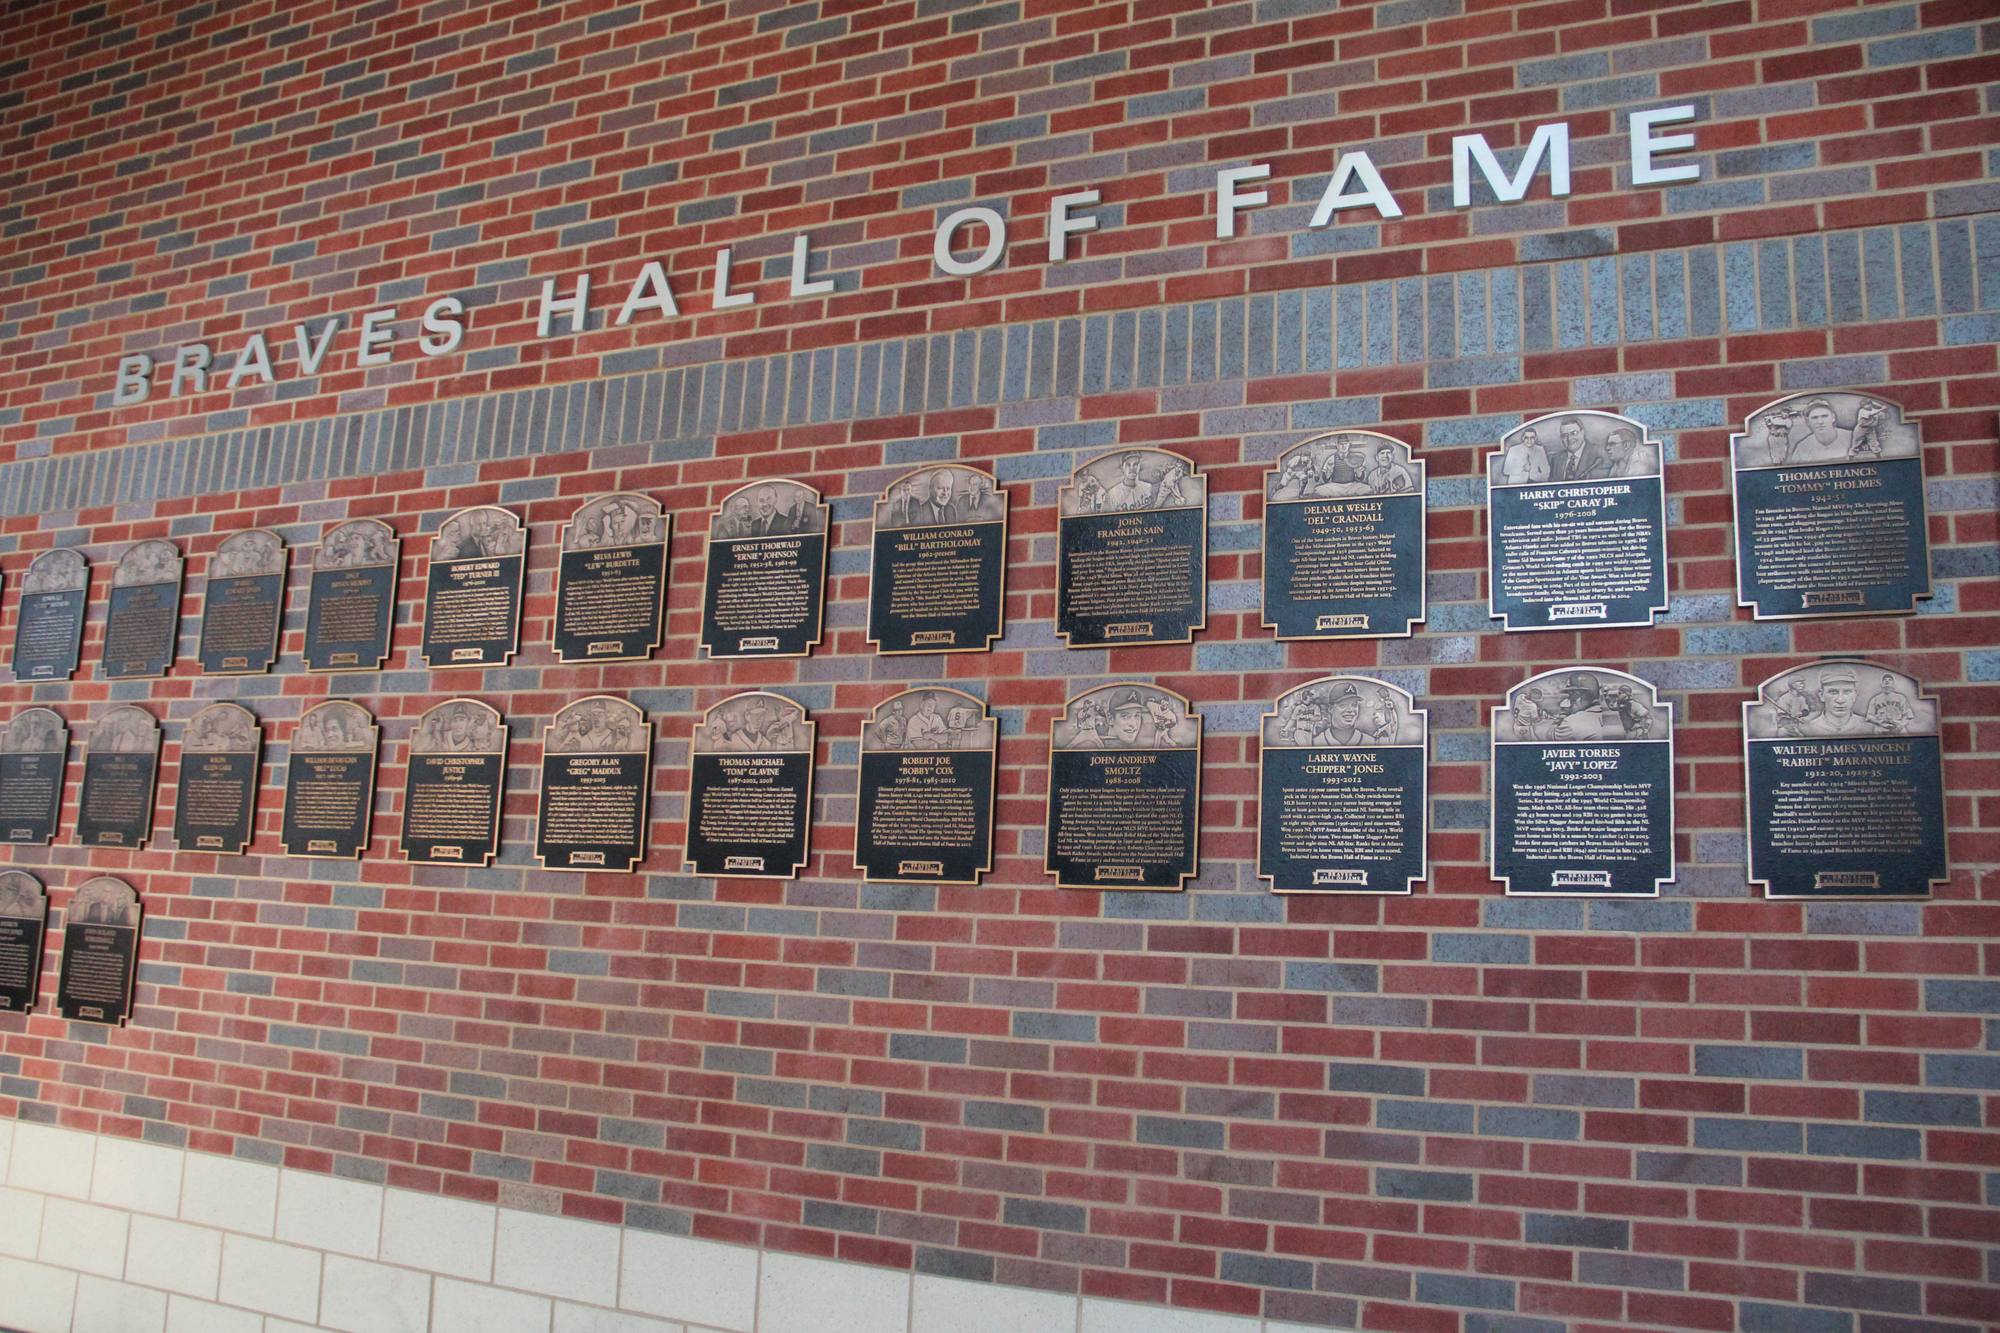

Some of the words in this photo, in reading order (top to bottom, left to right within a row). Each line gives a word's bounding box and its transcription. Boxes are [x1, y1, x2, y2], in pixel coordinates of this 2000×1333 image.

[112, 297, 464, 405] BRAVES
[537, 234, 836, 338] HALL
[934, 189, 1102, 277] OF
[1216, 105, 1701, 239] FAME
[1777, 471, 1827, 482] THOMAS
[1829, 467, 1877, 478] FRANCIS
[1834, 479, 1882, 490] HOLMES
[1520, 490, 1555, 500] HARRY
[1558, 485, 1631, 498] CHRISTOPHER
[1304, 504, 1344, 515] DELMAR
[1345, 502, 1383, 512] WESLEY
[1567, 498, 1601, 508] CARAY
[1603, 498, 1618, 508] JR.
[1332, 513, 1384, 524] CRANDALL
[1555, 510, 1597, 519] 1976-2008
[1117, 516, 1142, 529] JOHN
[903, 532, 937, 541] WILLIAM
[938, 529, 974, 539] CONRAD
[1097, 527, 1142, 538] FRANKLIN
[1143, 526, 1164, 535] SAIN
[732, 543, 759, 552] ERNEST
[760, 540, 802, 550] THORWALD
[920, 538, 982, 550] BARTHOLOMAY
[763, 550, 798, 561] JOHNSON
[1541, 749, 1576, 760] JAVIER
[1578, 749, 1620, 758] TORRES
[1772, 745, 1818, 755] WALTER
[1820, 744, 1857, 756] JAMES
[1859, 743, 1912, 753] VINCENT
[600, 758, 620, 766] ALAN
[718, 758, 750, 766] THOMAS
[751, 758, 785, 766] MICHAEL
[902, 756, 935, 765] ROBERT
[935, 756, 951, 766] JOE
[1090, 756, 1115, 767] JOHN
[1117, 755, 1157, 764] ANDREW
[1308, 754, 1341, 763] LARRY
[1342, 753, 1377, 762] WAYNE
[1833, 756, 1911, 766] MARANVILLE
[935, 766, 954, 775] COX
[1104, 766, 1142, 775] SMOLTZ
[1352, 764, 1384, 775] JONES
[1583, 760, 1618, 770] LOPEZ
[1322, 777, 1362, 785] 1993-2012
[1560, 773, 1603, 781] 1992-2003
